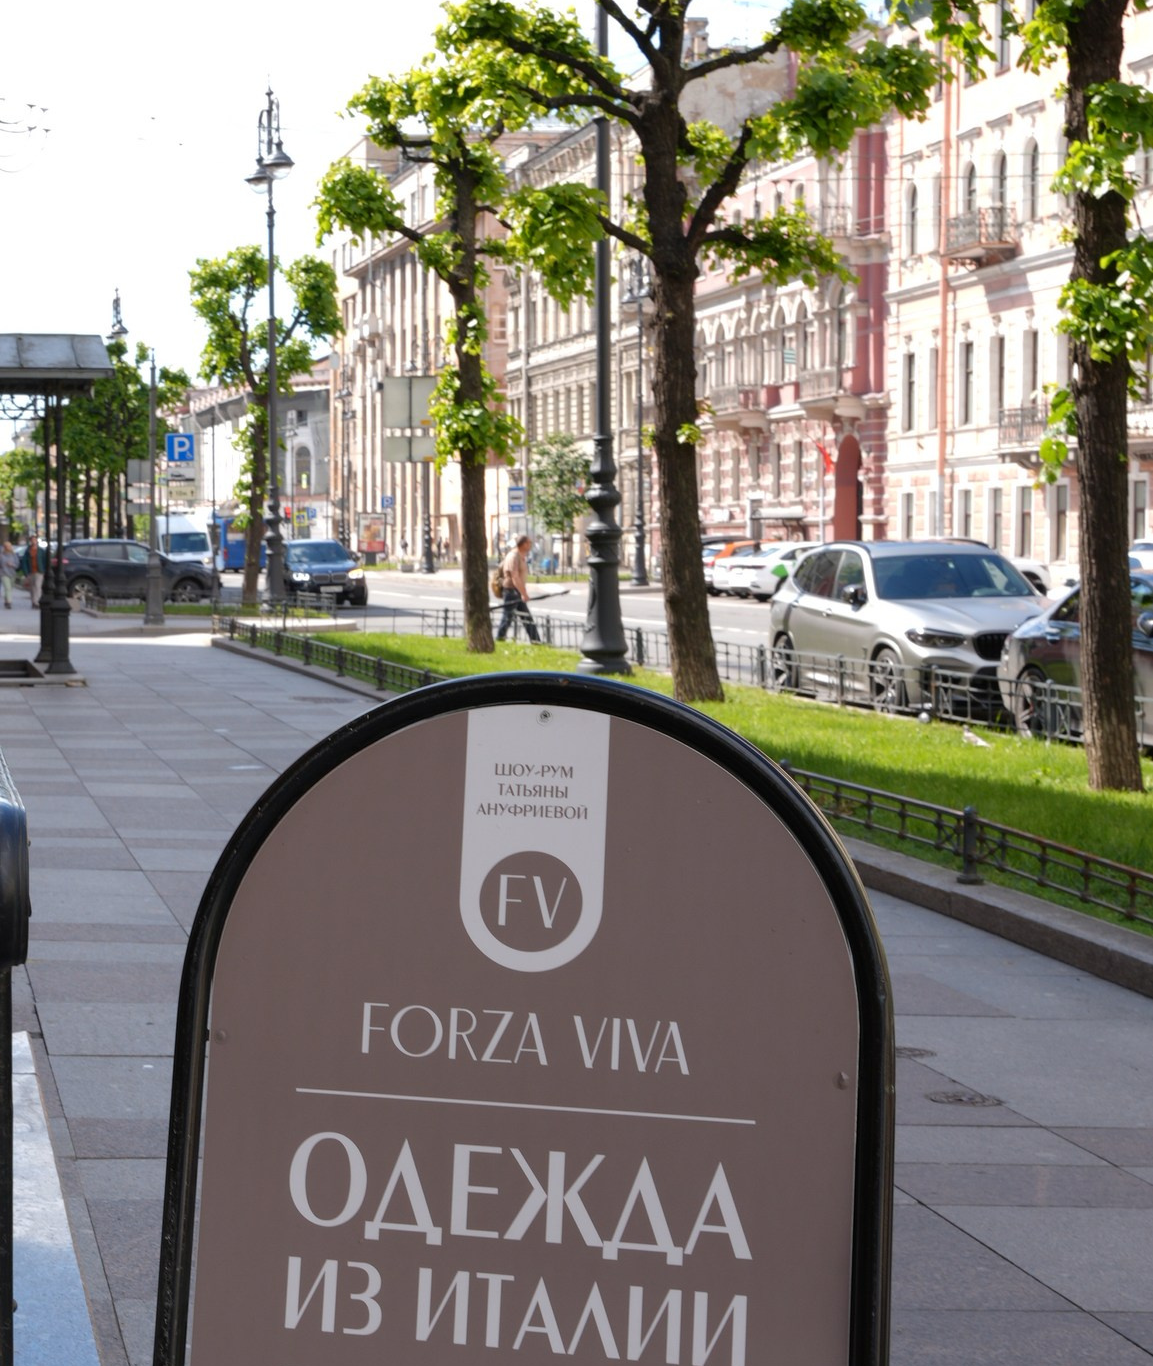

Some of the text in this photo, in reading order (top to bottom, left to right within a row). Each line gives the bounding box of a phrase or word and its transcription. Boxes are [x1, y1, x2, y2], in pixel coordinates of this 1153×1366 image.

[494, 762, 574, 779] ШОУ-РУМ
[497, 782, 569, 799] ТАТЬЯНЫ
[476, 802, 589, 820] АНУФРИЕВОЙ
[497, 874, 567, 929] FV
[361, 1002, 690, 1076] FORZA VIVA
[289, 1131, 753, 1266] ОДЕЖДА
[284, 1256, 383, 1336] ИЗ
